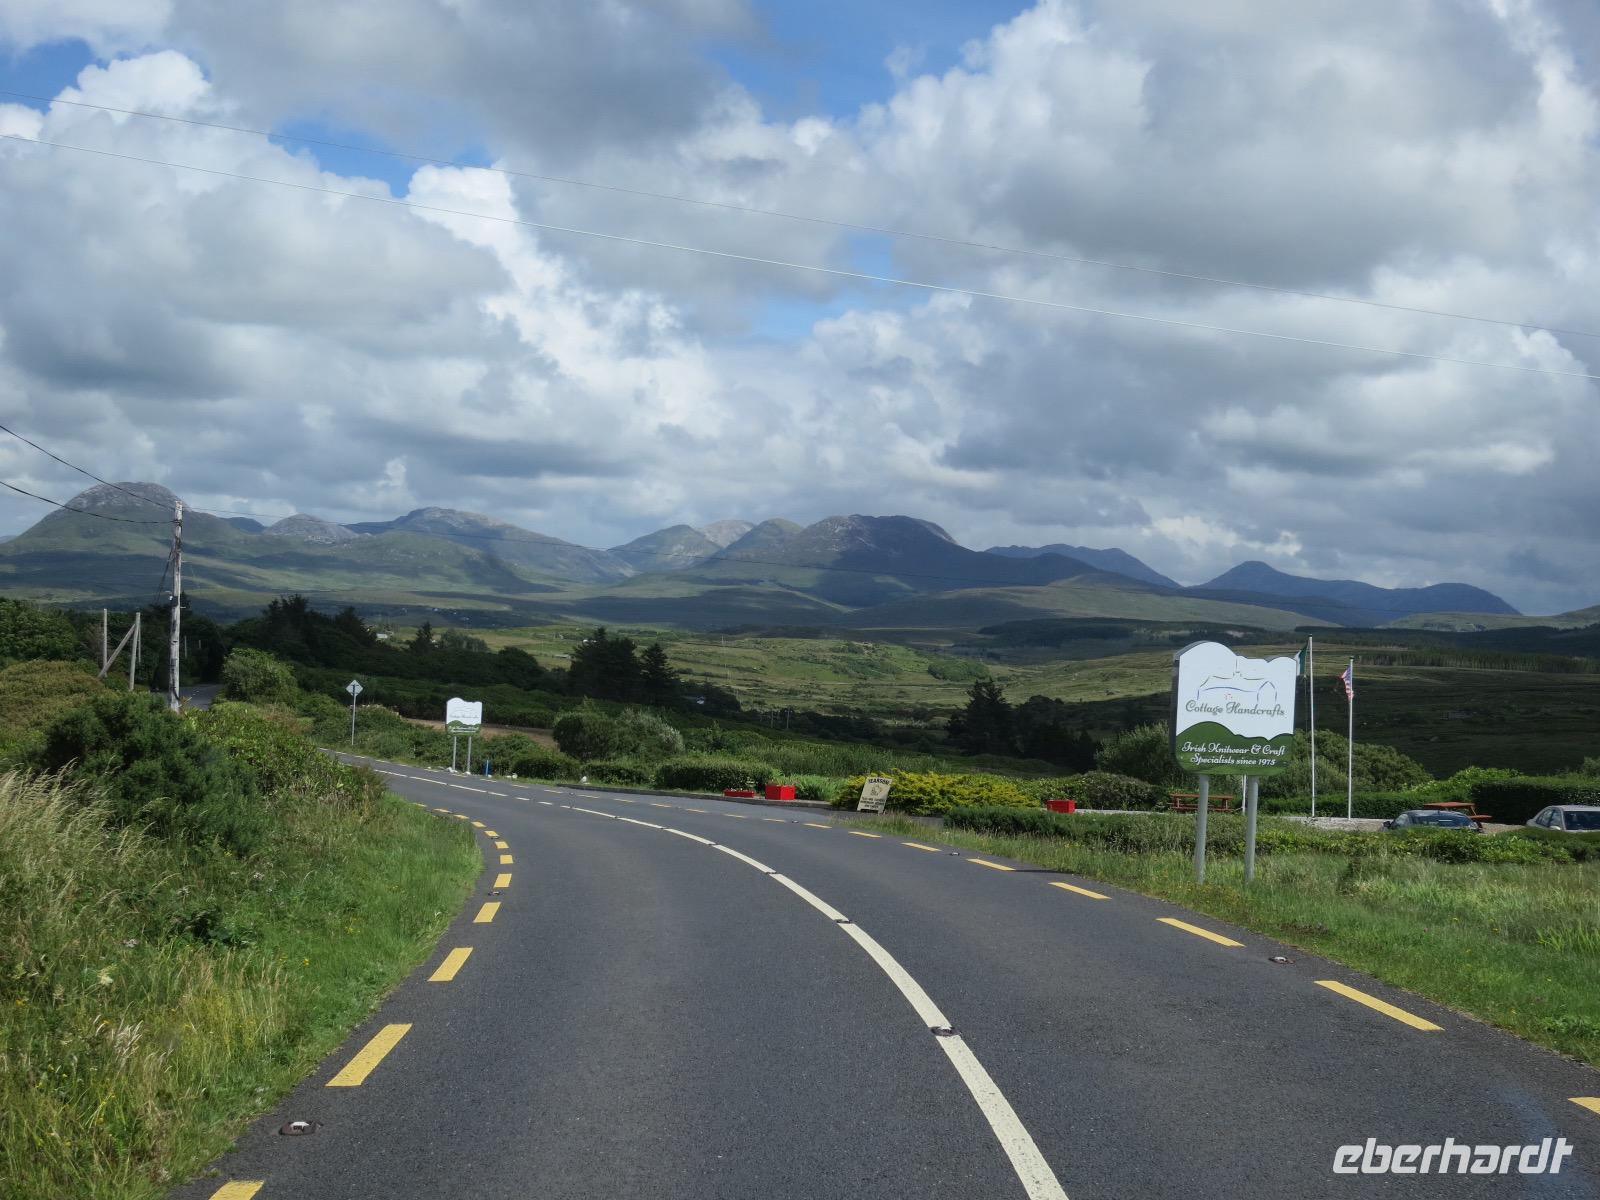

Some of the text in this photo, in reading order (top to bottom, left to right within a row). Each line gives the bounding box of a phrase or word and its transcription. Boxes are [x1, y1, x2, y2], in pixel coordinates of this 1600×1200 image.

[1185, 699, 1285, 718] Cottage Handcrafts
[1182, 741, 1286, 757] Irish Knitwear & Craft
[1191, 753, 1234, 766] Specialists
[1258, 758, 1276, 766] 1975
